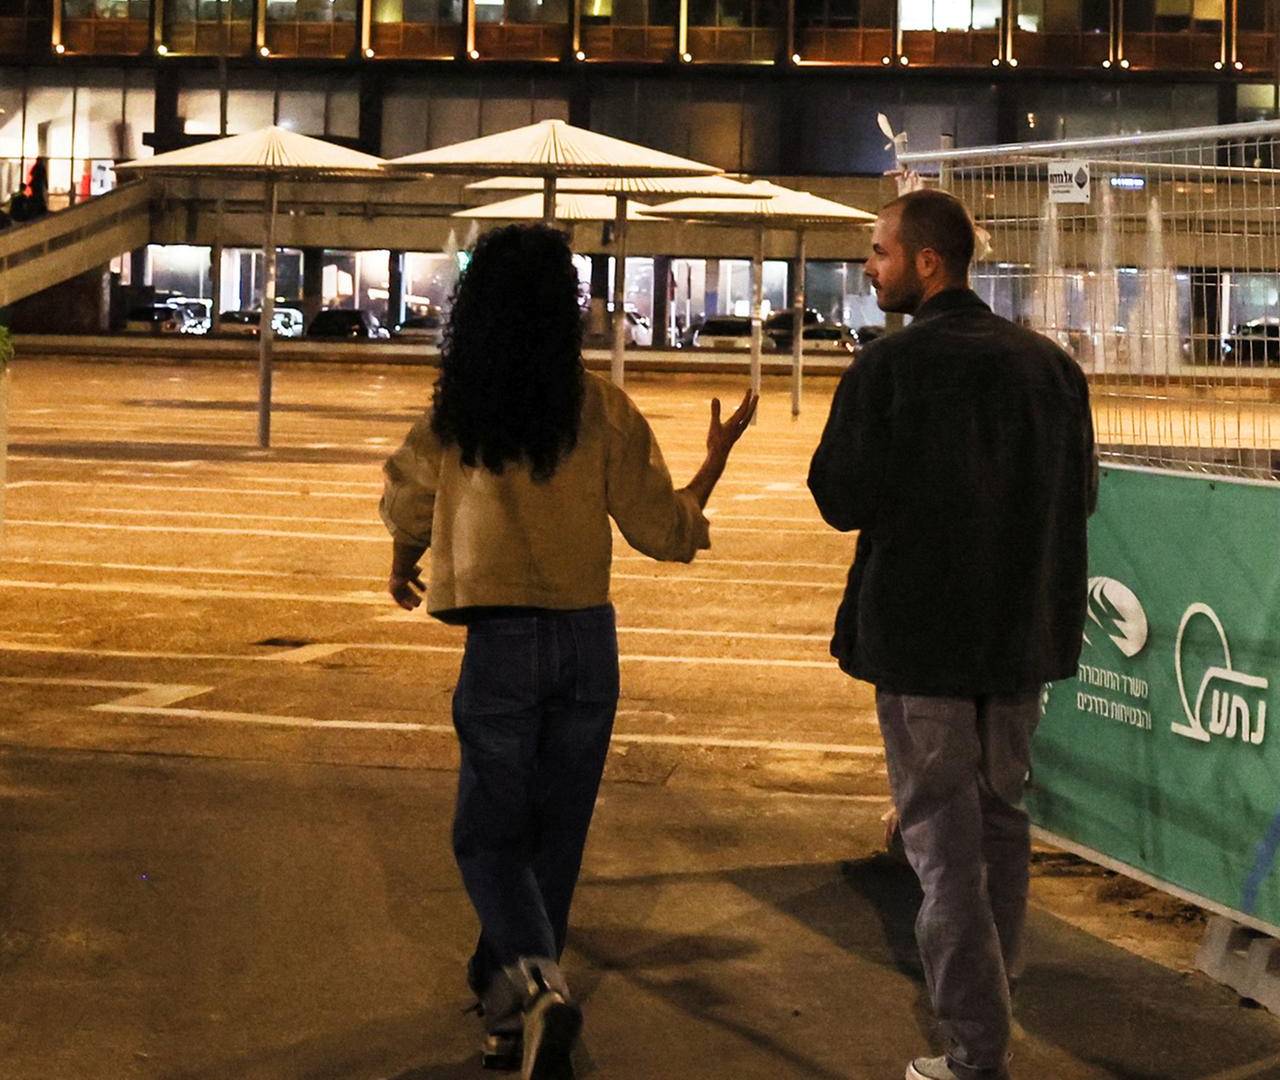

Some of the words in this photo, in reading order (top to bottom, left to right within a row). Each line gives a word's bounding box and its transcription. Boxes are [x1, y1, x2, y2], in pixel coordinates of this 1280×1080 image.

[1078, 663, 1120, 691] התחבורה
[1120, 674, 1148, 699] משרד
[1077, 691, 1110, 718] בדרכים
[1110, 701, 1152, 731] והבטיחות
